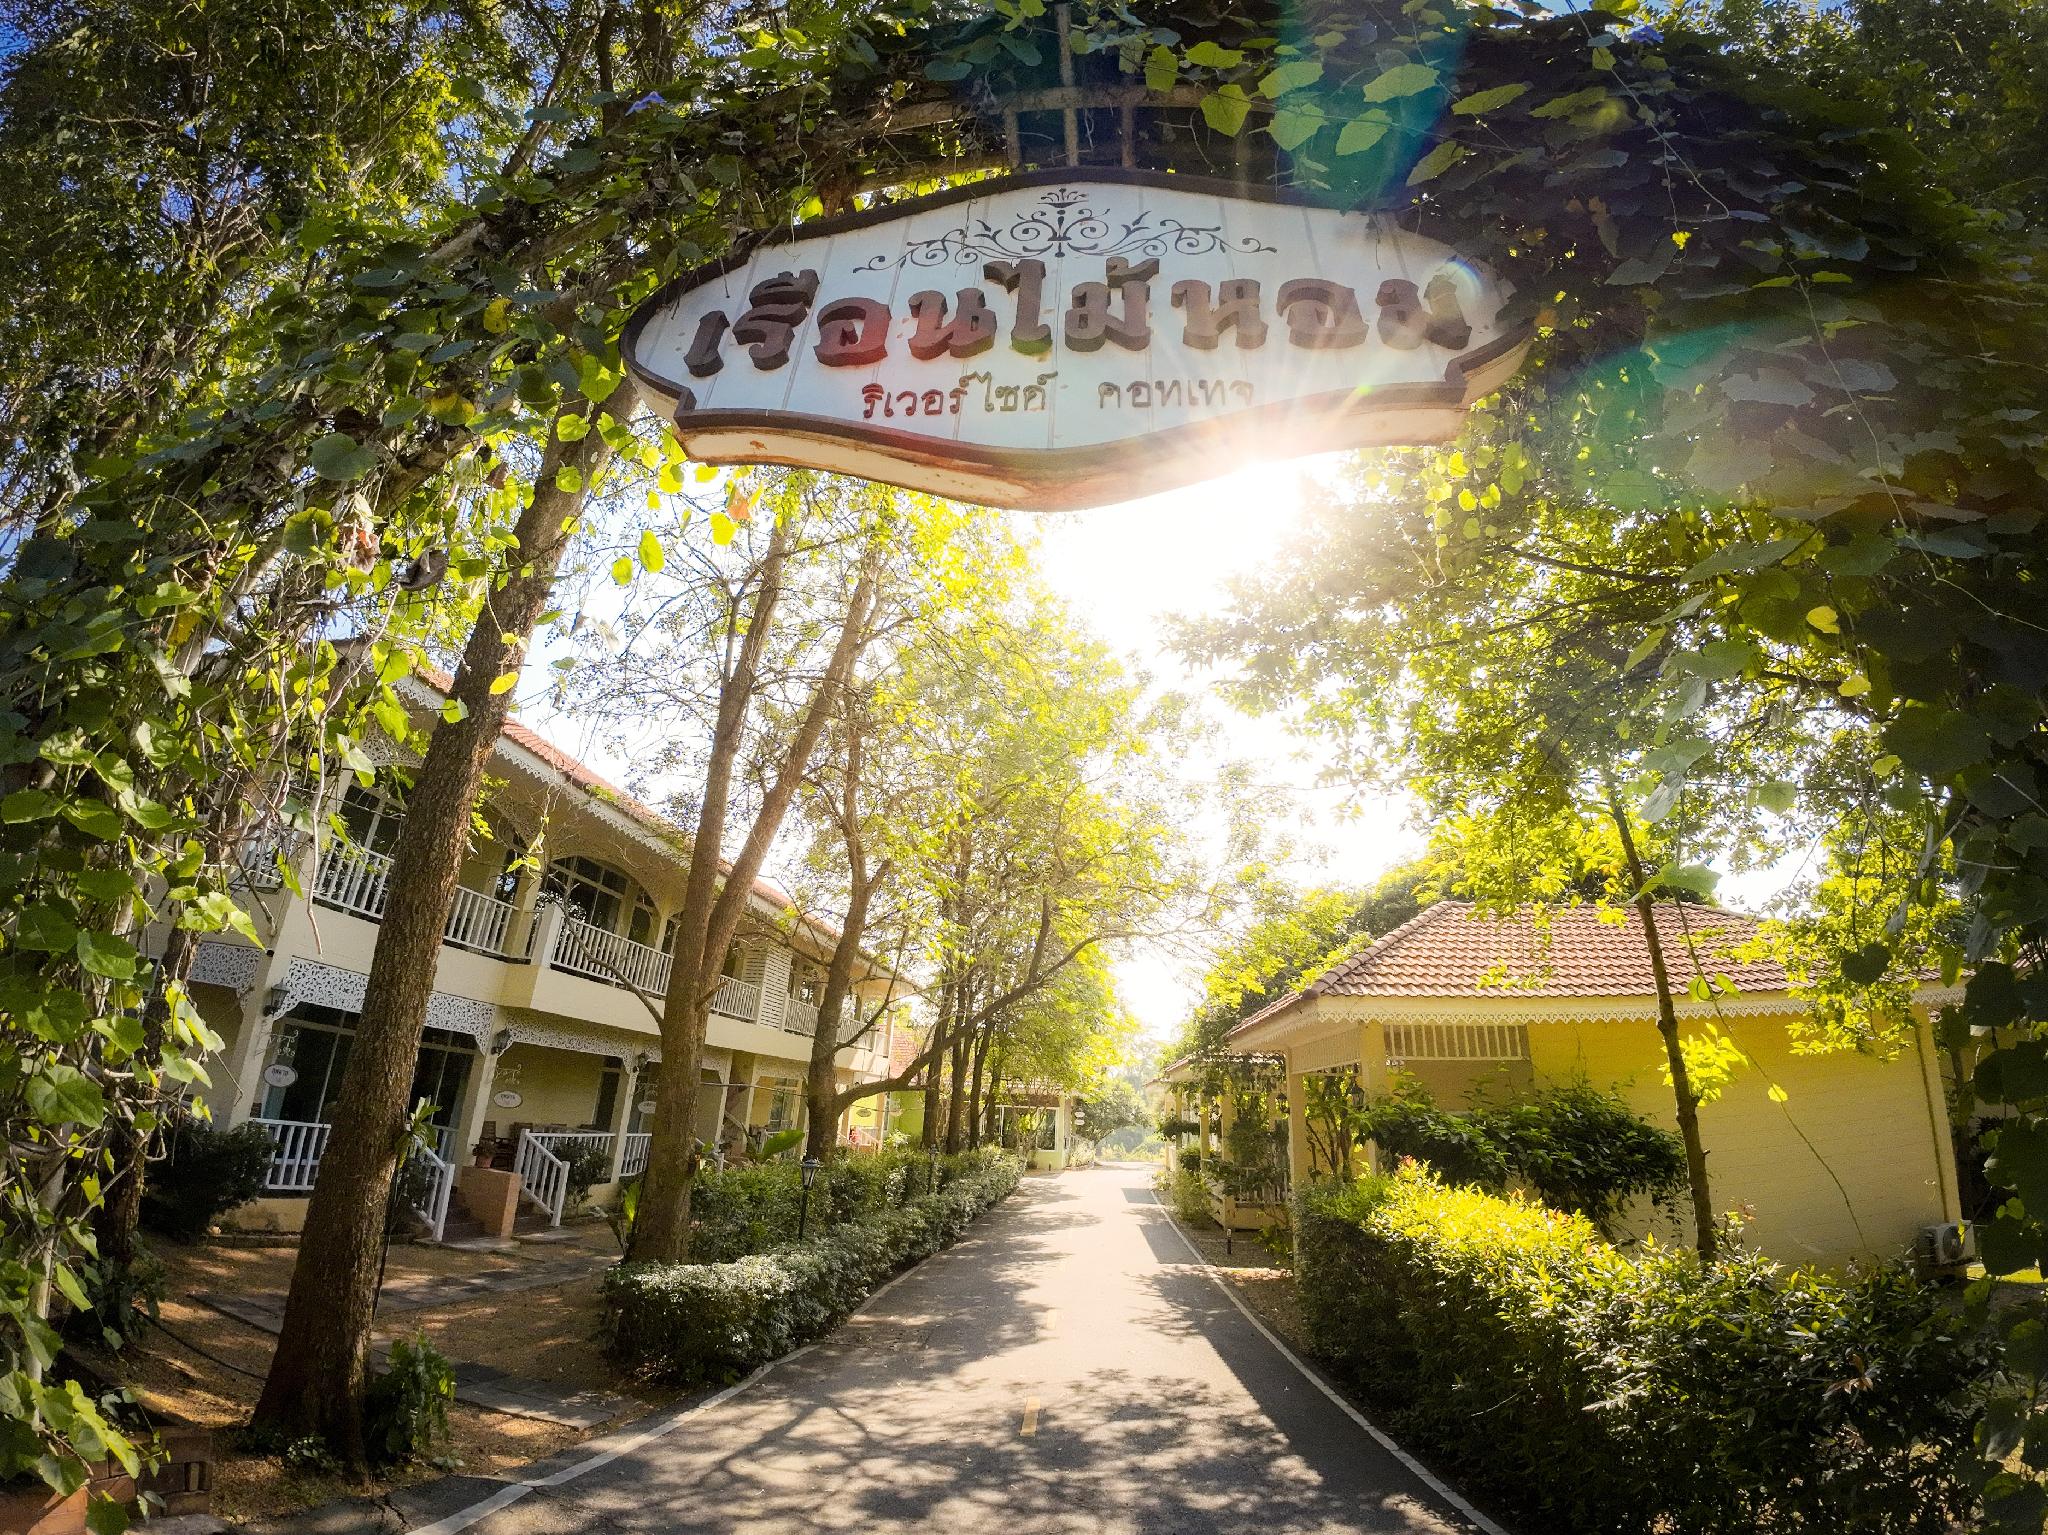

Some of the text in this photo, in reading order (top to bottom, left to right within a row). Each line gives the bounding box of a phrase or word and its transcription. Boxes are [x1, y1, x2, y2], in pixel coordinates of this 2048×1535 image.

[683, 256, 1472, 378] เรือนไม้หอม
[1097, 379, 1254, 409] คอทเทจ
